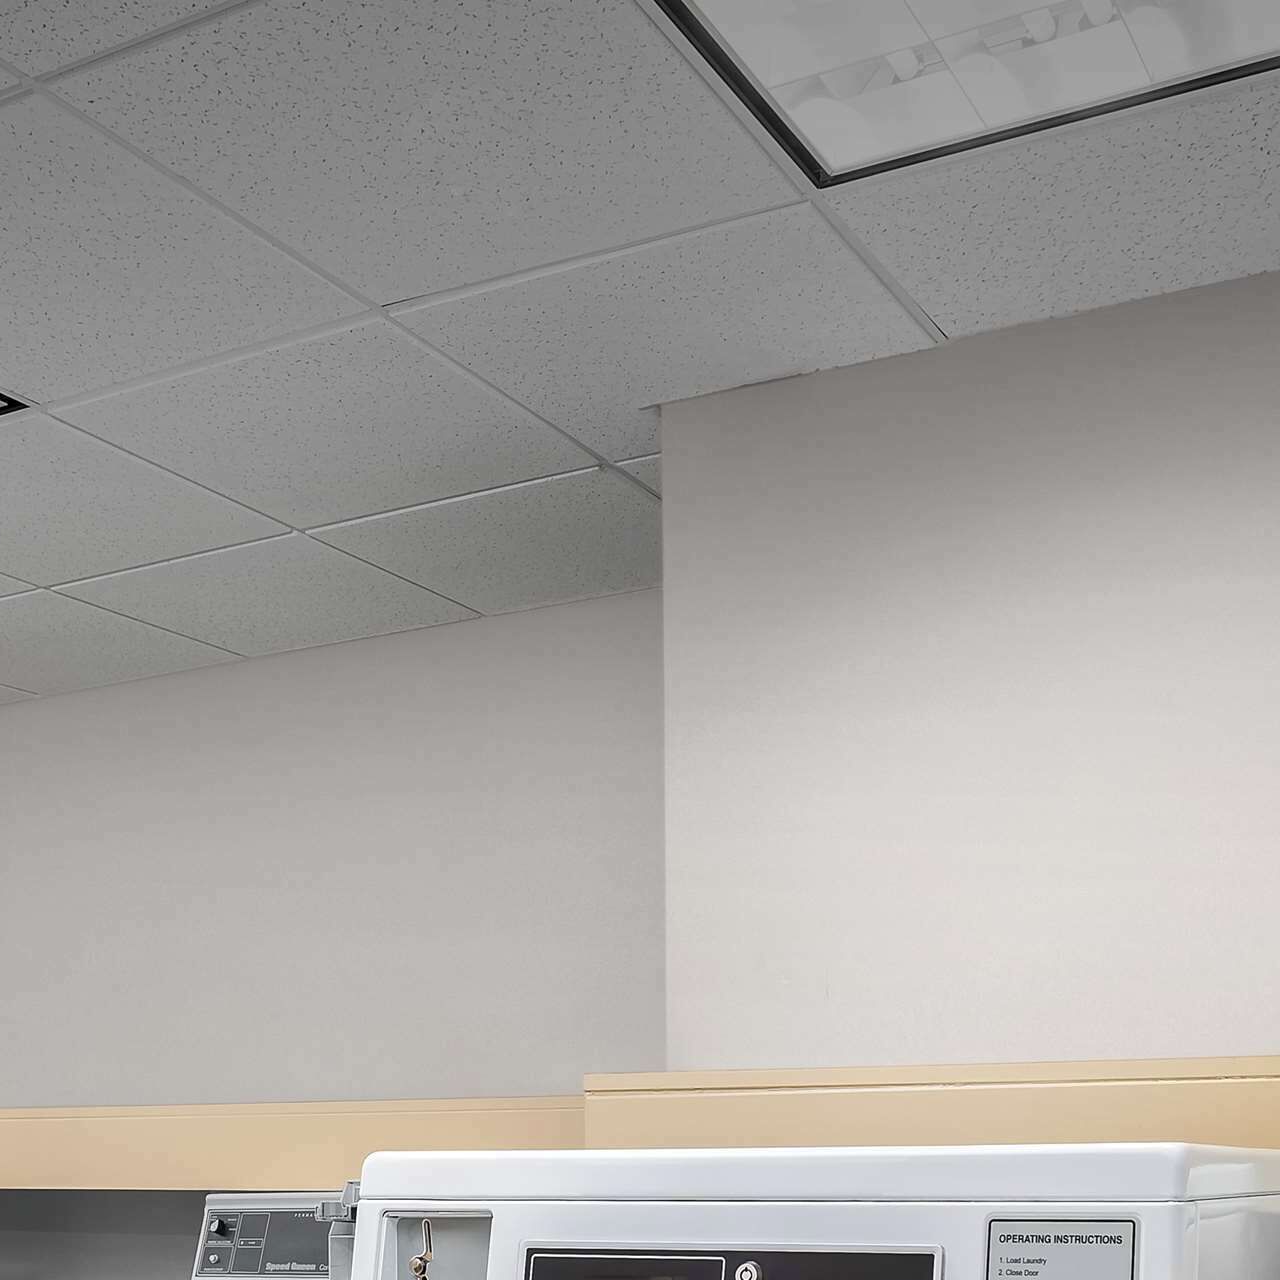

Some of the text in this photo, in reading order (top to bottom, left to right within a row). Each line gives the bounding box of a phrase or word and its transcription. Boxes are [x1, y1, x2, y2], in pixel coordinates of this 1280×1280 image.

[999, 1234, 1123, 1245] OPERATING INSTRUCTIONS
[1022, 1257, 1047, 1266] Laundry
[1024, 1269, 1039, 1277] Door
